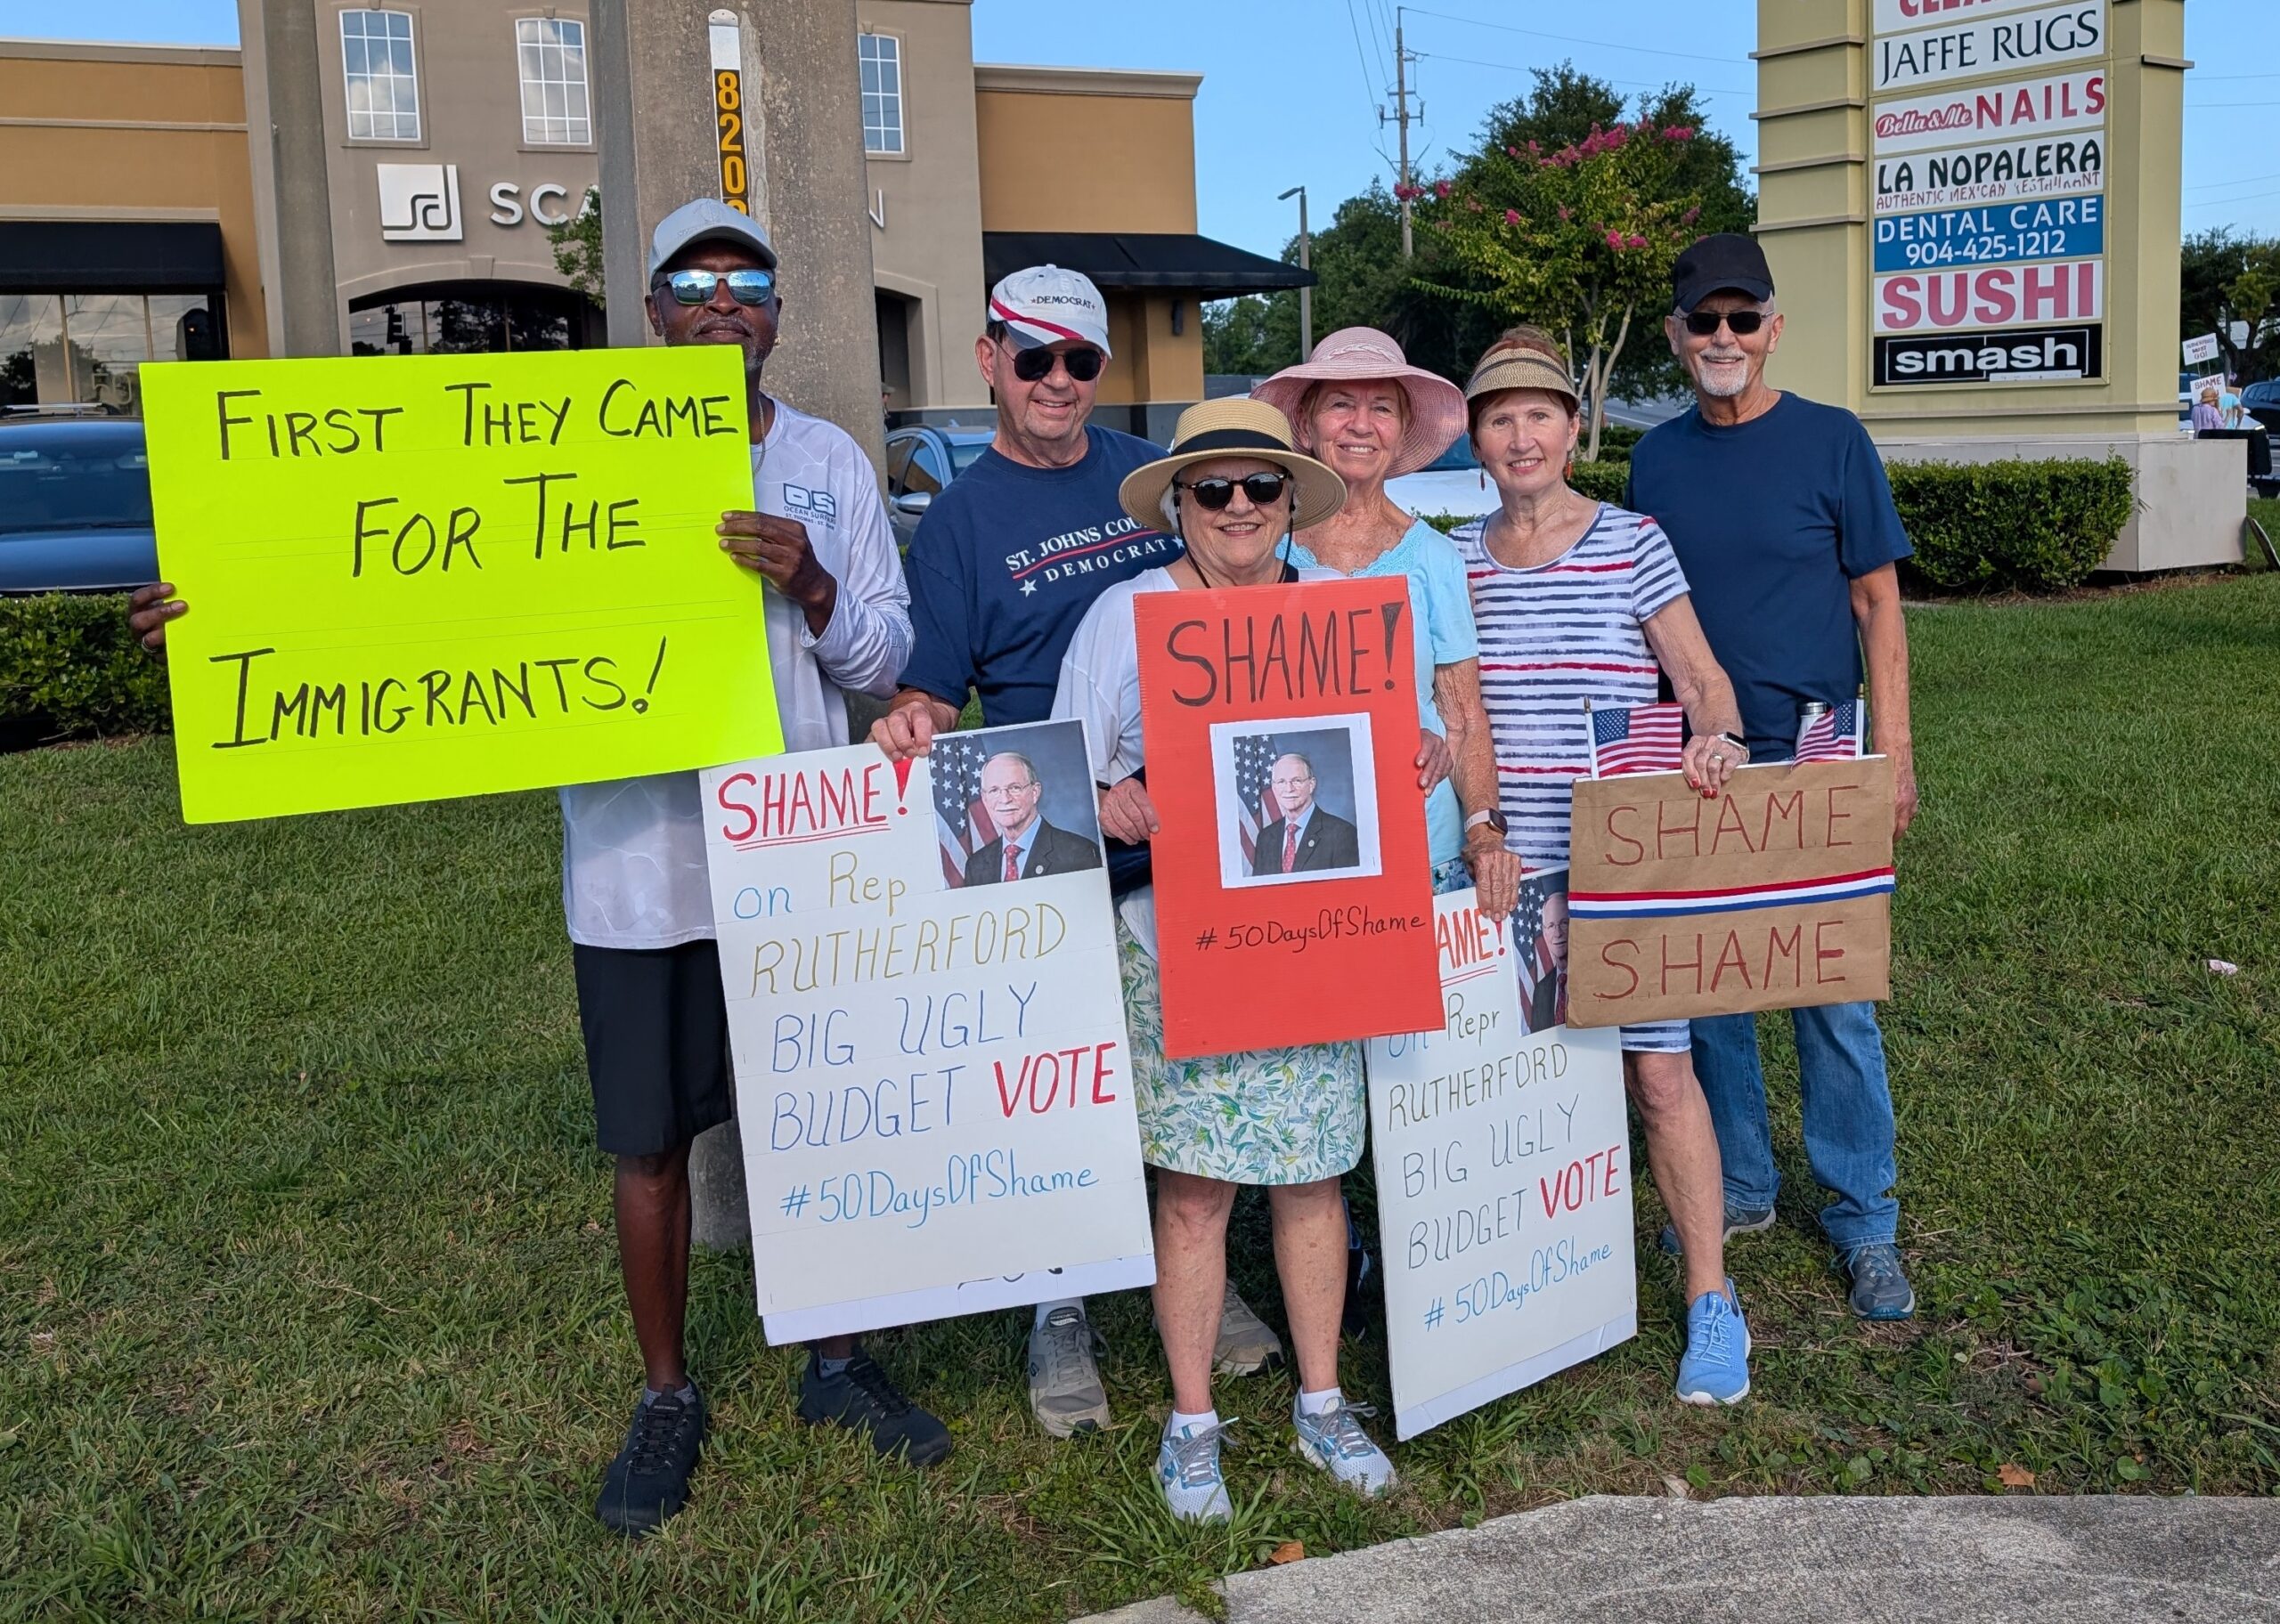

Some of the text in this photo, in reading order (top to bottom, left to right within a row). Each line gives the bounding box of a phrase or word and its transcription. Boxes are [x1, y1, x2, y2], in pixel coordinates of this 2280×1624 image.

[1881, 9, 2099, 85] JAFFE RUGS
[1976, 77, 2105, 130] NAILS
[716, 70, 749, 215] 820
[1878, 139, 2101, 194] LA NOPALERA
[1877, 187, 1943, 210] AUTHENTIC
[1878, 198, 2097, 242] DENTAL CARE
[1906, 230, 2065, 266] 904-425-1212
[1037, 296, 1092, 309] DEMOCRAT
[1882, 263, 2094, 329] SUSHI
[1894, 337, 2078, 373] smash
[2194, 376, 2222, 389] SHAME
[217, 379, 739, 459] FIRST THEY CAME
[353, 472, 647, 577] FOR THE
[784, 505, 809, 516] OCEAN
[1006, 516, 1147, 572] ST. JOHNS COU
[1044, 539, 1167, 582] DEMOCRAT
[1167, 601, 1405, 707] SHAME!
[209, 636, 667, 749] IMMIGRANTS!
[718, 757, 910, 841] SHAME!
[1606, 785, 1859, 866] SHAME
[734, 851, 907, 919] on Rep
[751, 903, 1066, 998] RUTHERFORD
[1437, 908, 1505, 970] AME!
[1593, 921, 1846, 999] SHAME
[772, 981, 1037, 1072] BIG UGLY
[1448, 993, 1500, 1047] Repr
[771, 1042, 1118, 1150] BUDGET VOTE
[1389, 1043, 1568, 1132] RUTHERFORD
[1404, 1094, 1579, 1198] BIG UGLY
[1408, 1145, 1622, 1271] BUDGET VOTE
